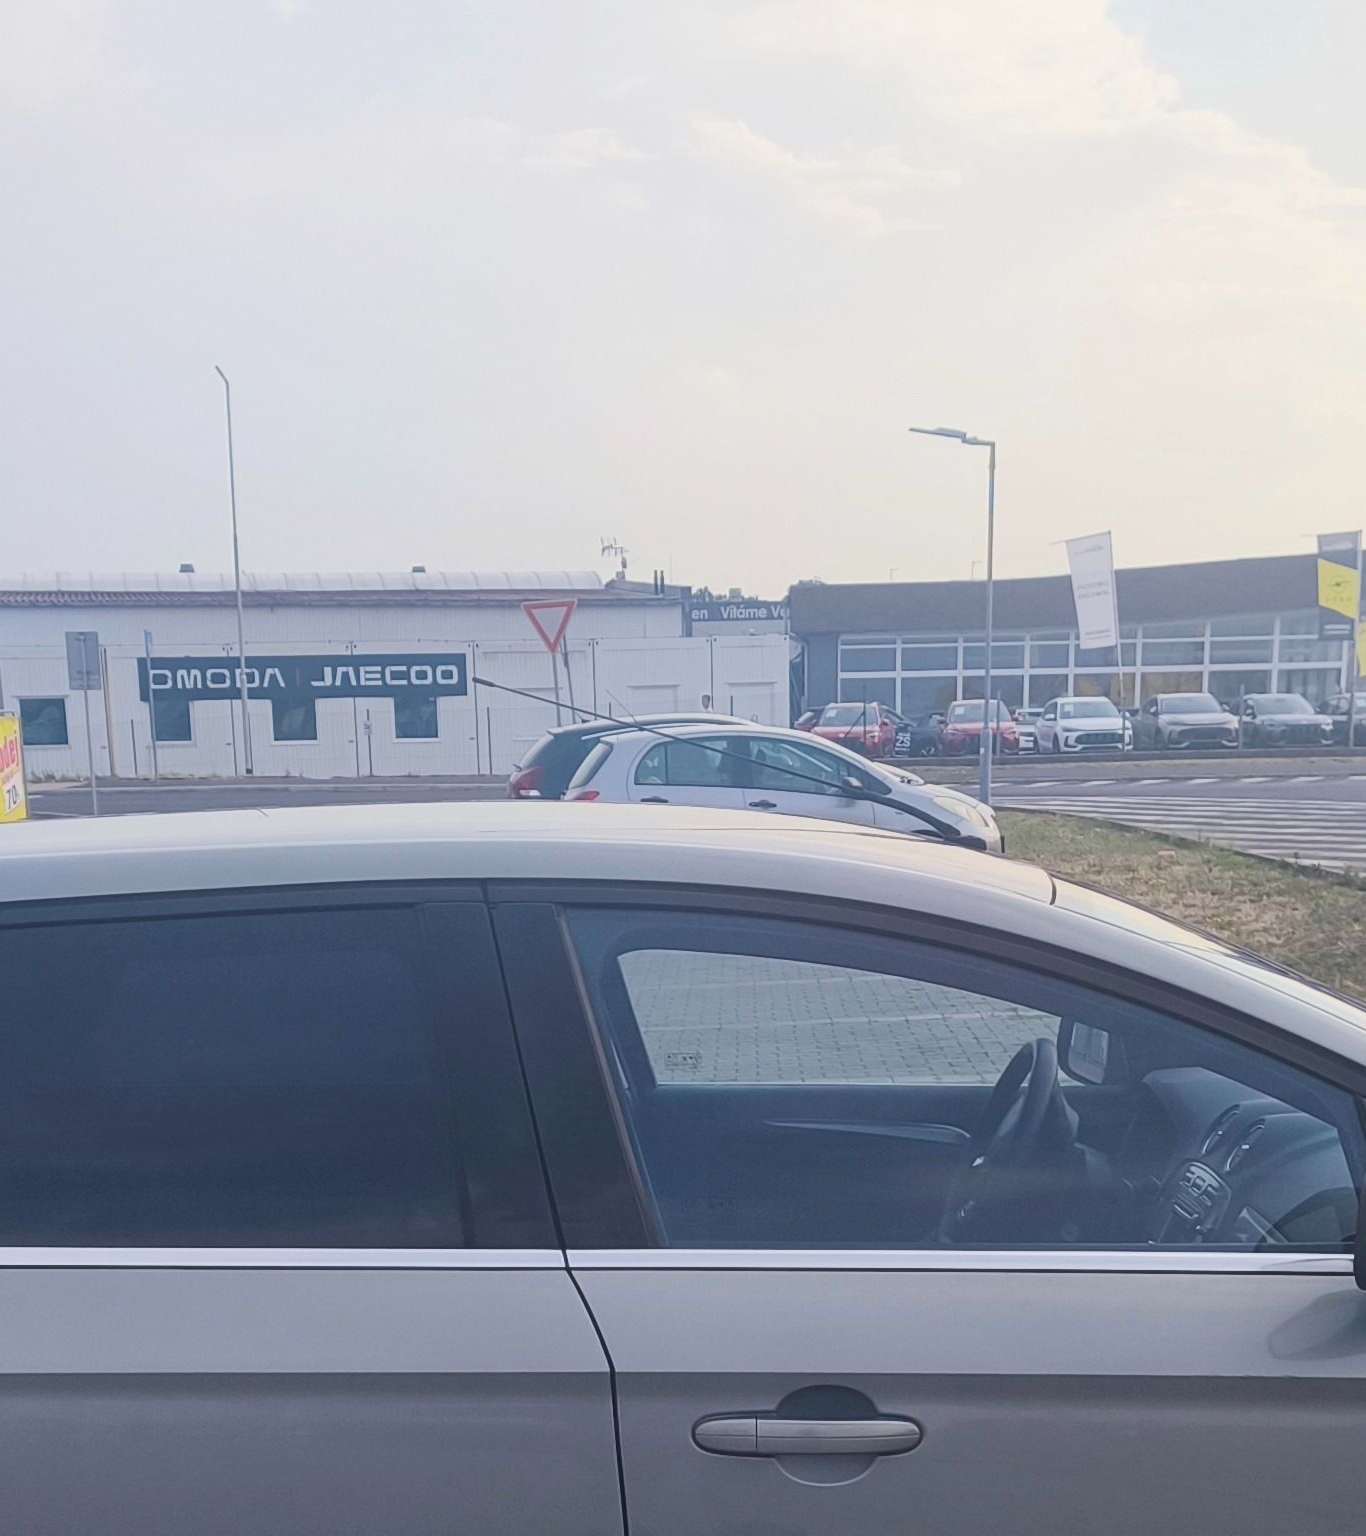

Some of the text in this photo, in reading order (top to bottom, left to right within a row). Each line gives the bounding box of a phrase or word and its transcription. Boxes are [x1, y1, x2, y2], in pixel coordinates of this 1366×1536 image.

[691, 609, 709, 620] en
[720, 605, 767, 619] Vítáme
[151, 666, 459, 689] OMODA JAECOO
